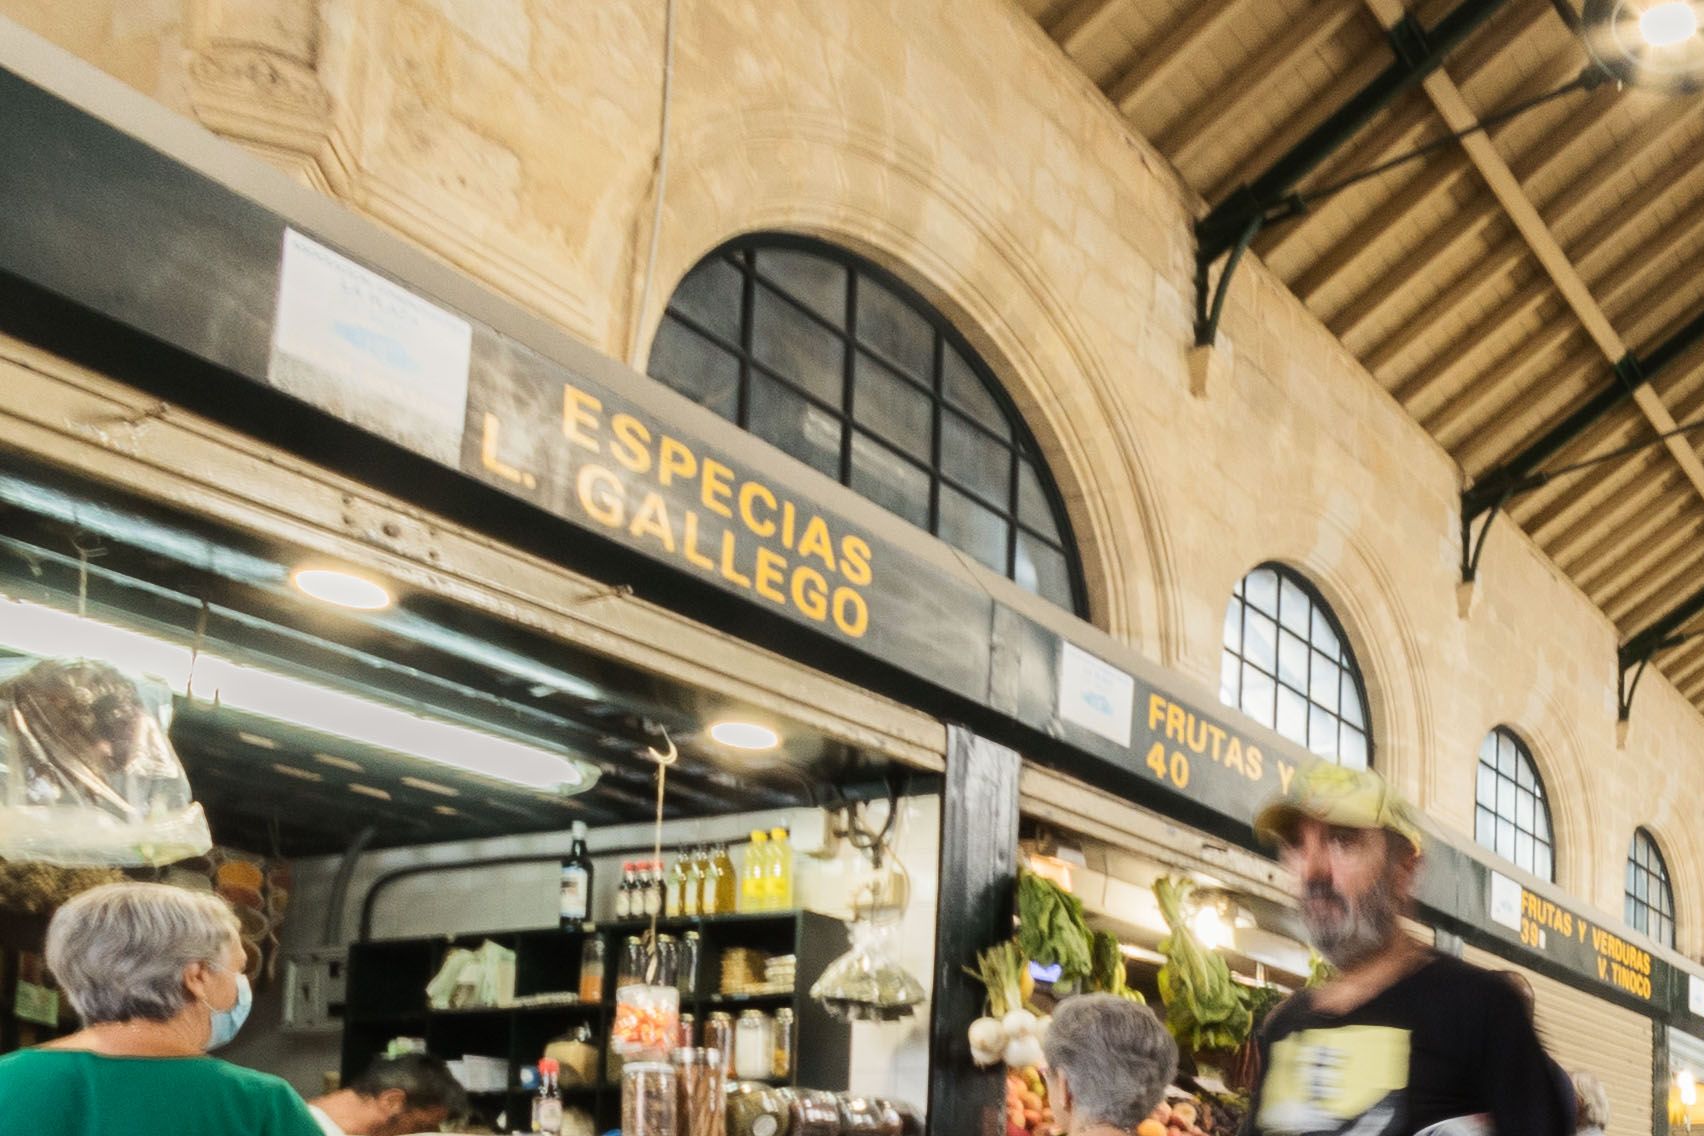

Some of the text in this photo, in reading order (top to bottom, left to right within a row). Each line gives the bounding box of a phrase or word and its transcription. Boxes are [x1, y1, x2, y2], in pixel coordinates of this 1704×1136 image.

[480, 411, 869, 639] L. GALLEGO
[562, 383, 873, 586] ESPECIAS
[1146, 741, 1190, 789] 40
[1149, 692, 1296, 797] FRUTAS Y
[1520, 916, 1540, 948] 39
[1521, 890, 1651, 977] FRUTAS Y VERDURAS
[1612, 962, 1652, 1001] TINOCO
